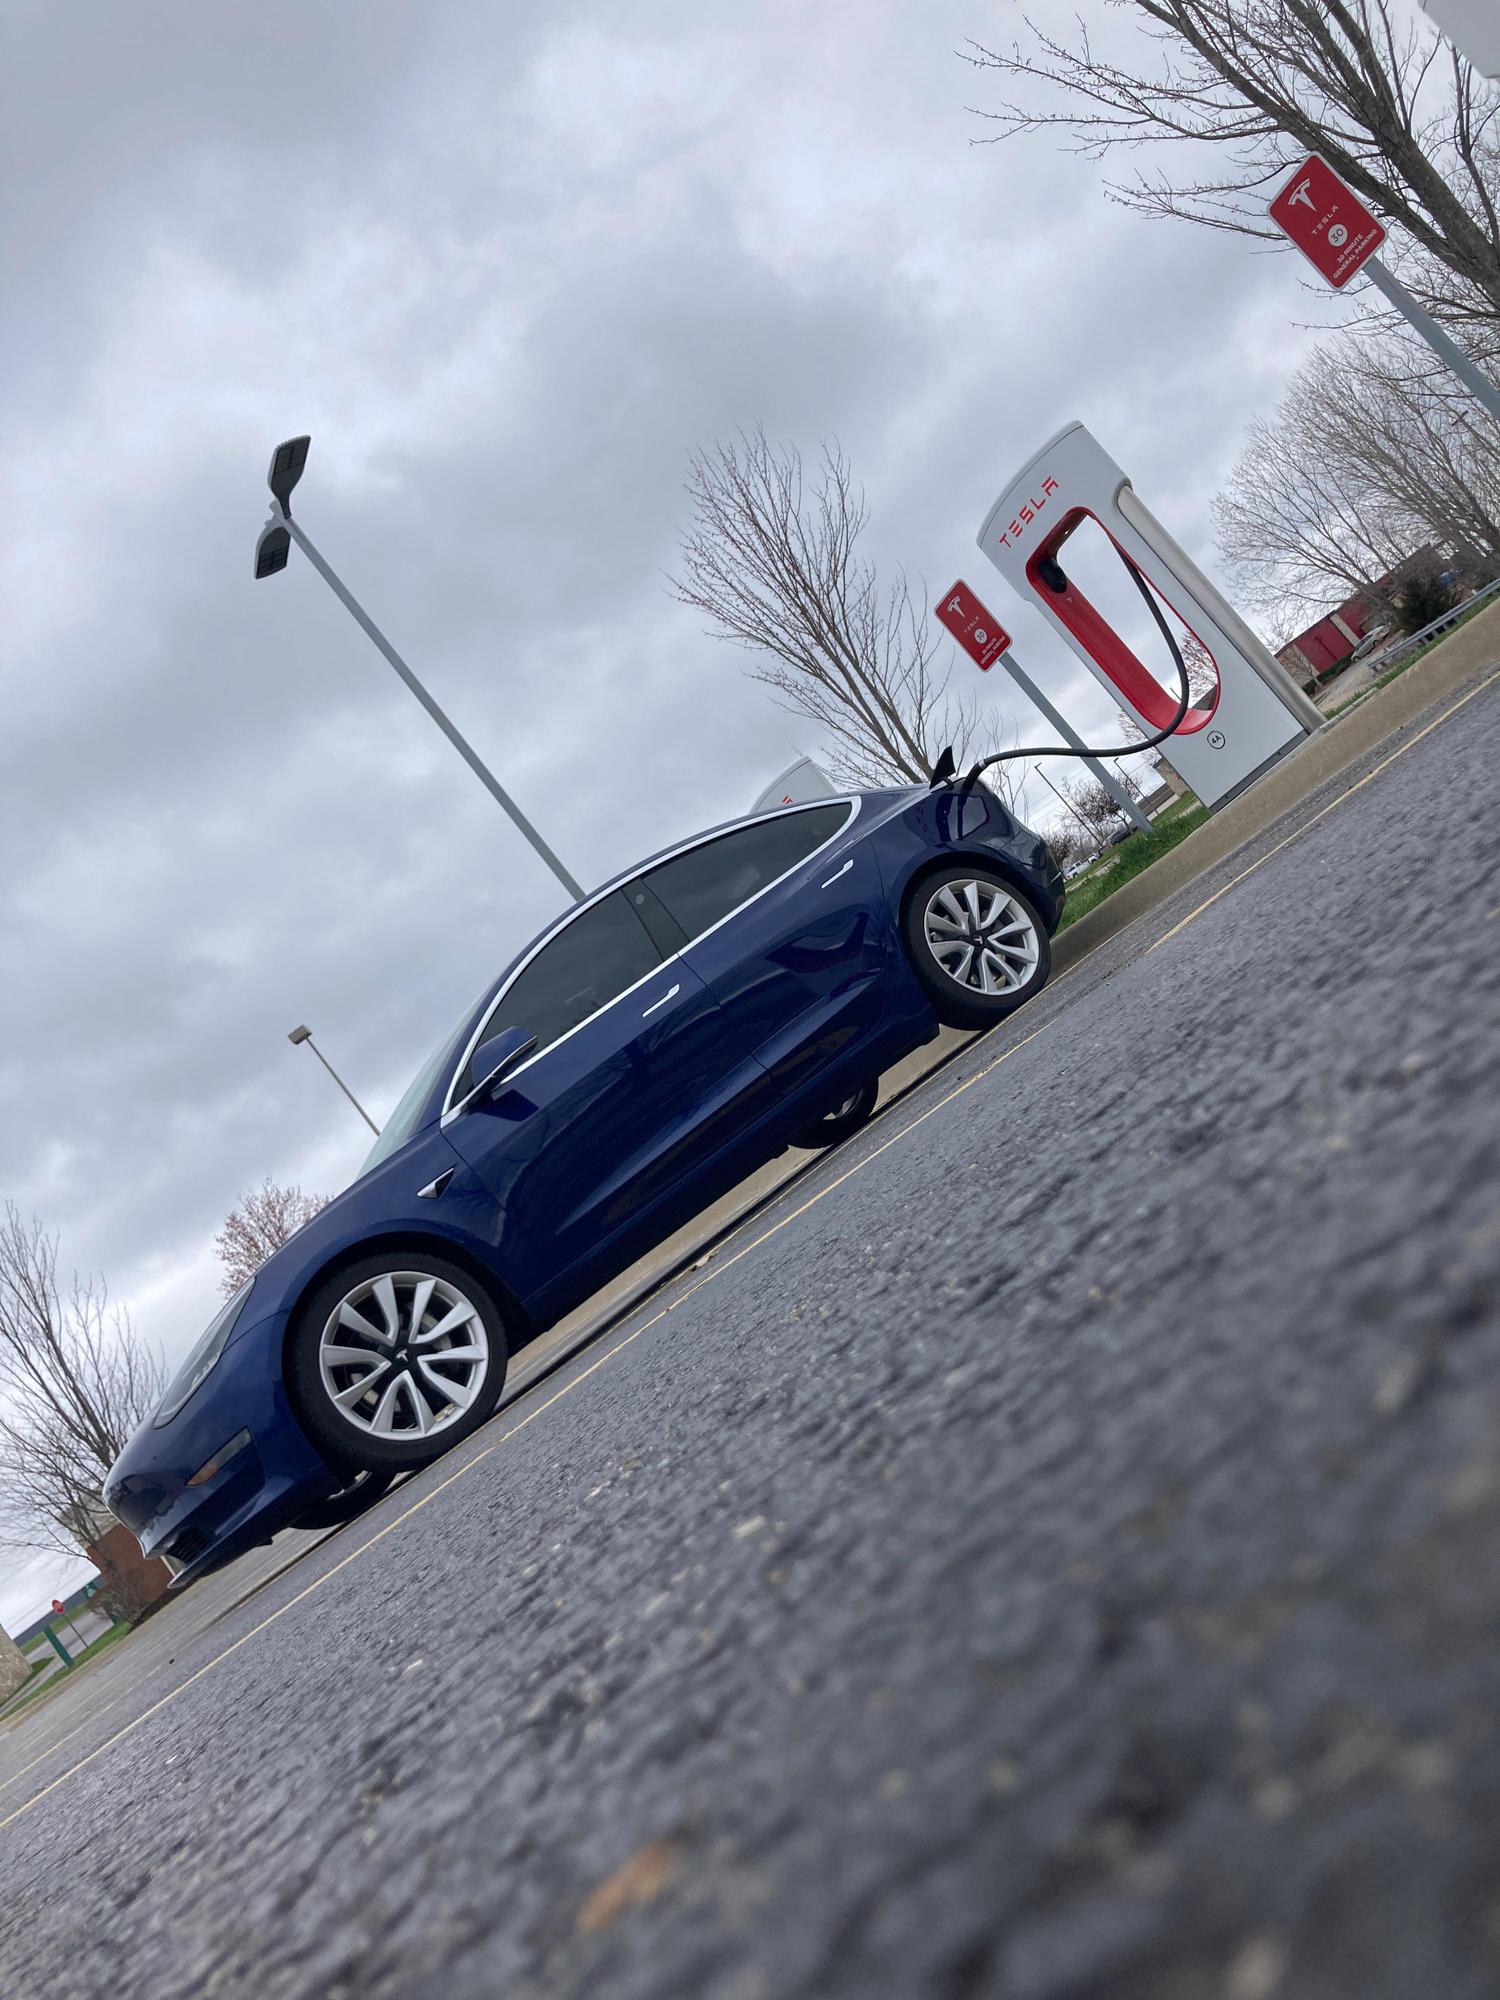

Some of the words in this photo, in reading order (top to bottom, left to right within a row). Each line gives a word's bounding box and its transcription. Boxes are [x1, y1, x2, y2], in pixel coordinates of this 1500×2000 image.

[1311, 204, 1340, 236] TESLA
[1330, 227, 1344, 243] 30
[1333, 253, 1356, 279] GENERAL
[1354, 228, 1378, 255] PARKING
[1344, 233, 1364, 255] MINUTE
[998, 475, 1059, 548] TESLA
